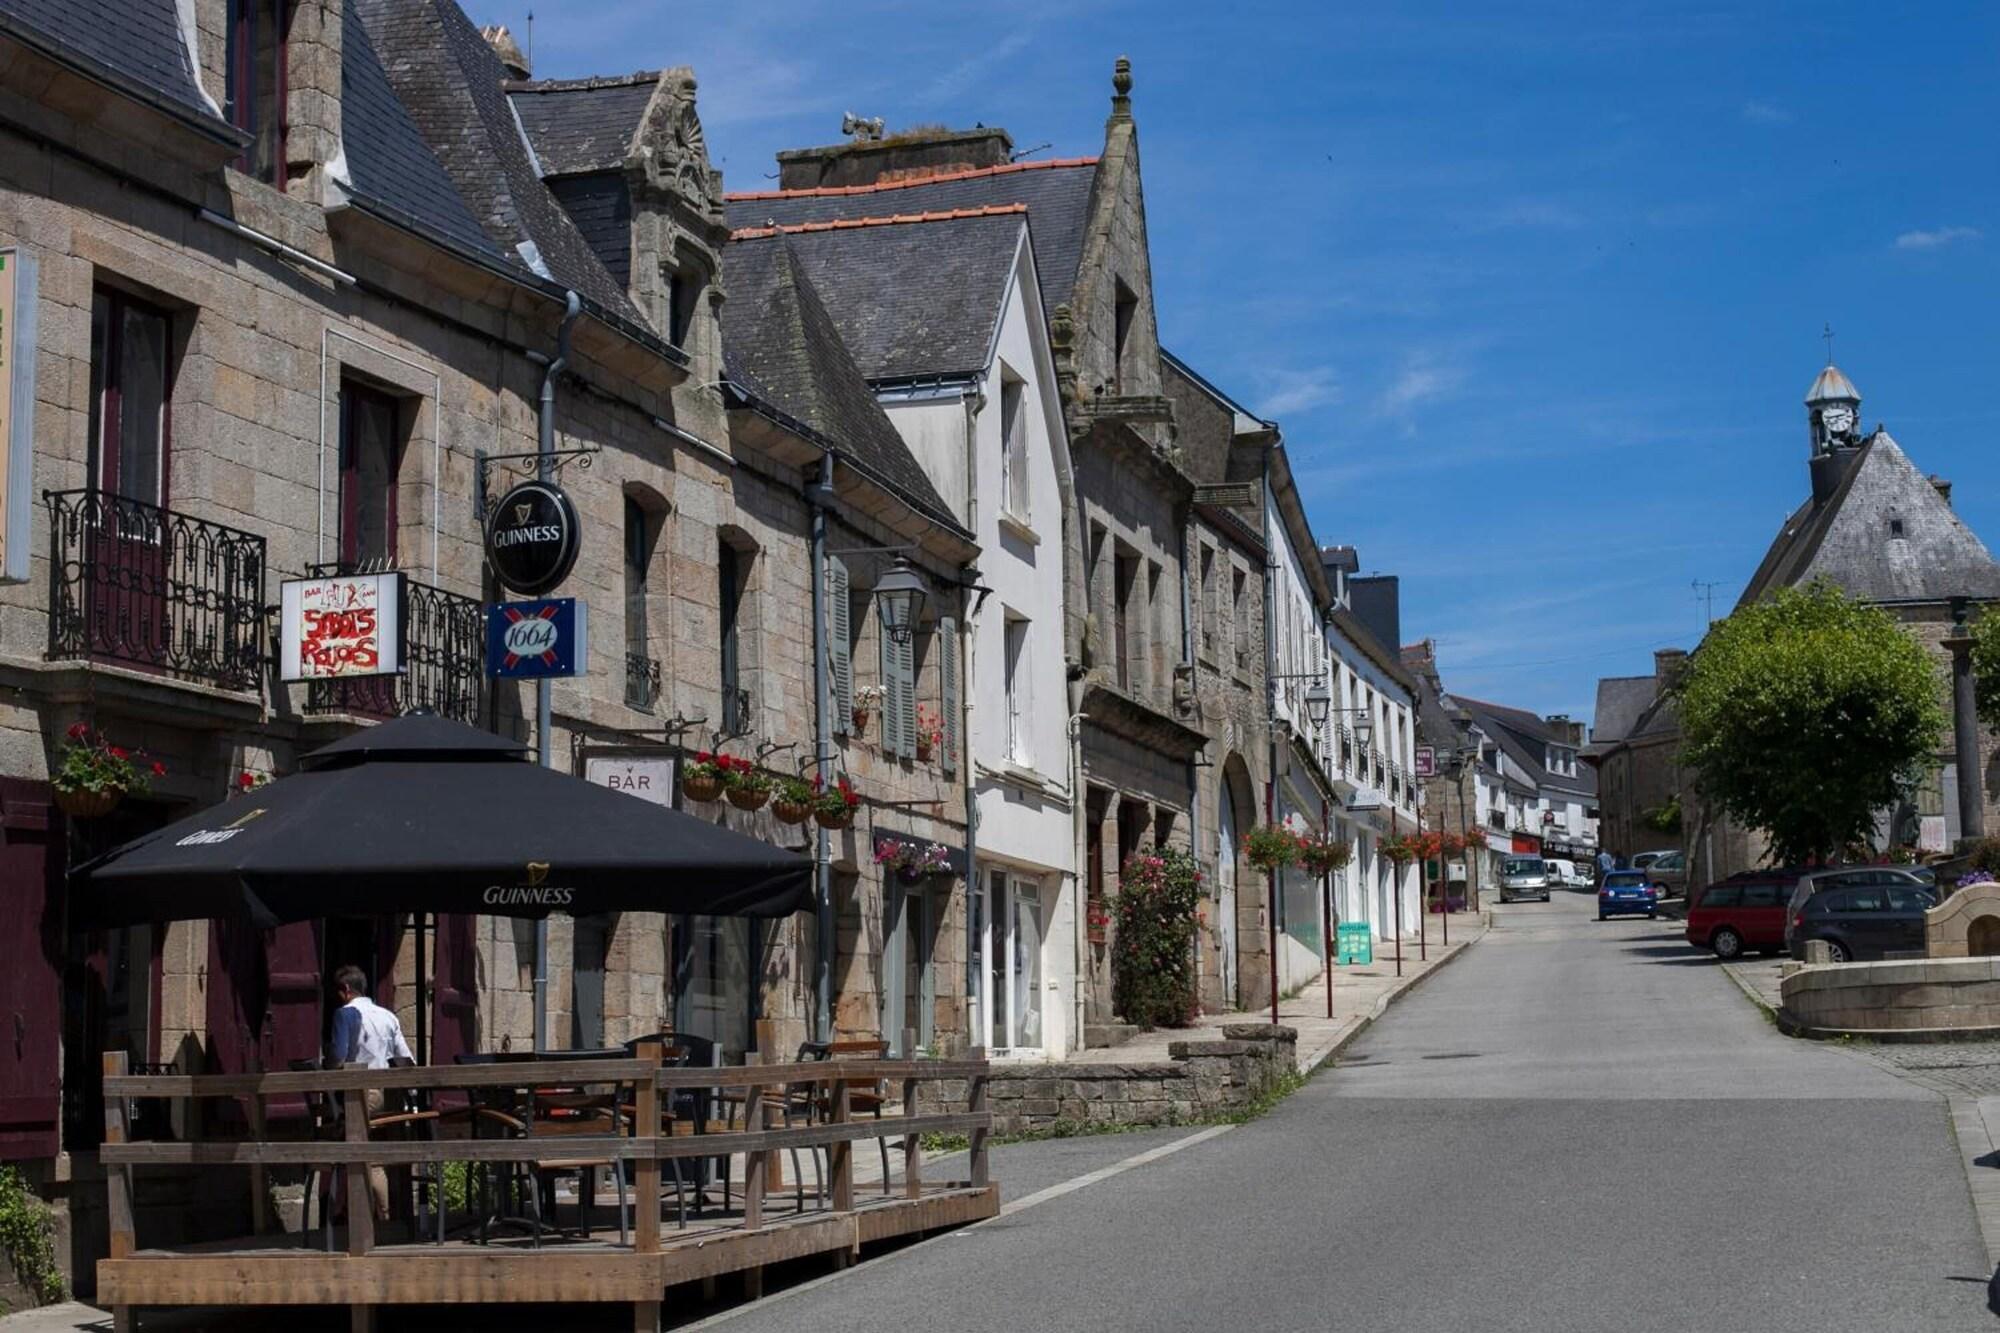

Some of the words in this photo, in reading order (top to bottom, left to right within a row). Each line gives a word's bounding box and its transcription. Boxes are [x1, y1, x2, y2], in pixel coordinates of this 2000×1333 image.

[494, 525, 561, 548] GUINNESS
[508, 623, 553, 648] 1664
[608, 775, 651, 790] BAR
[483, 886, 576, 904] GUINNESS
